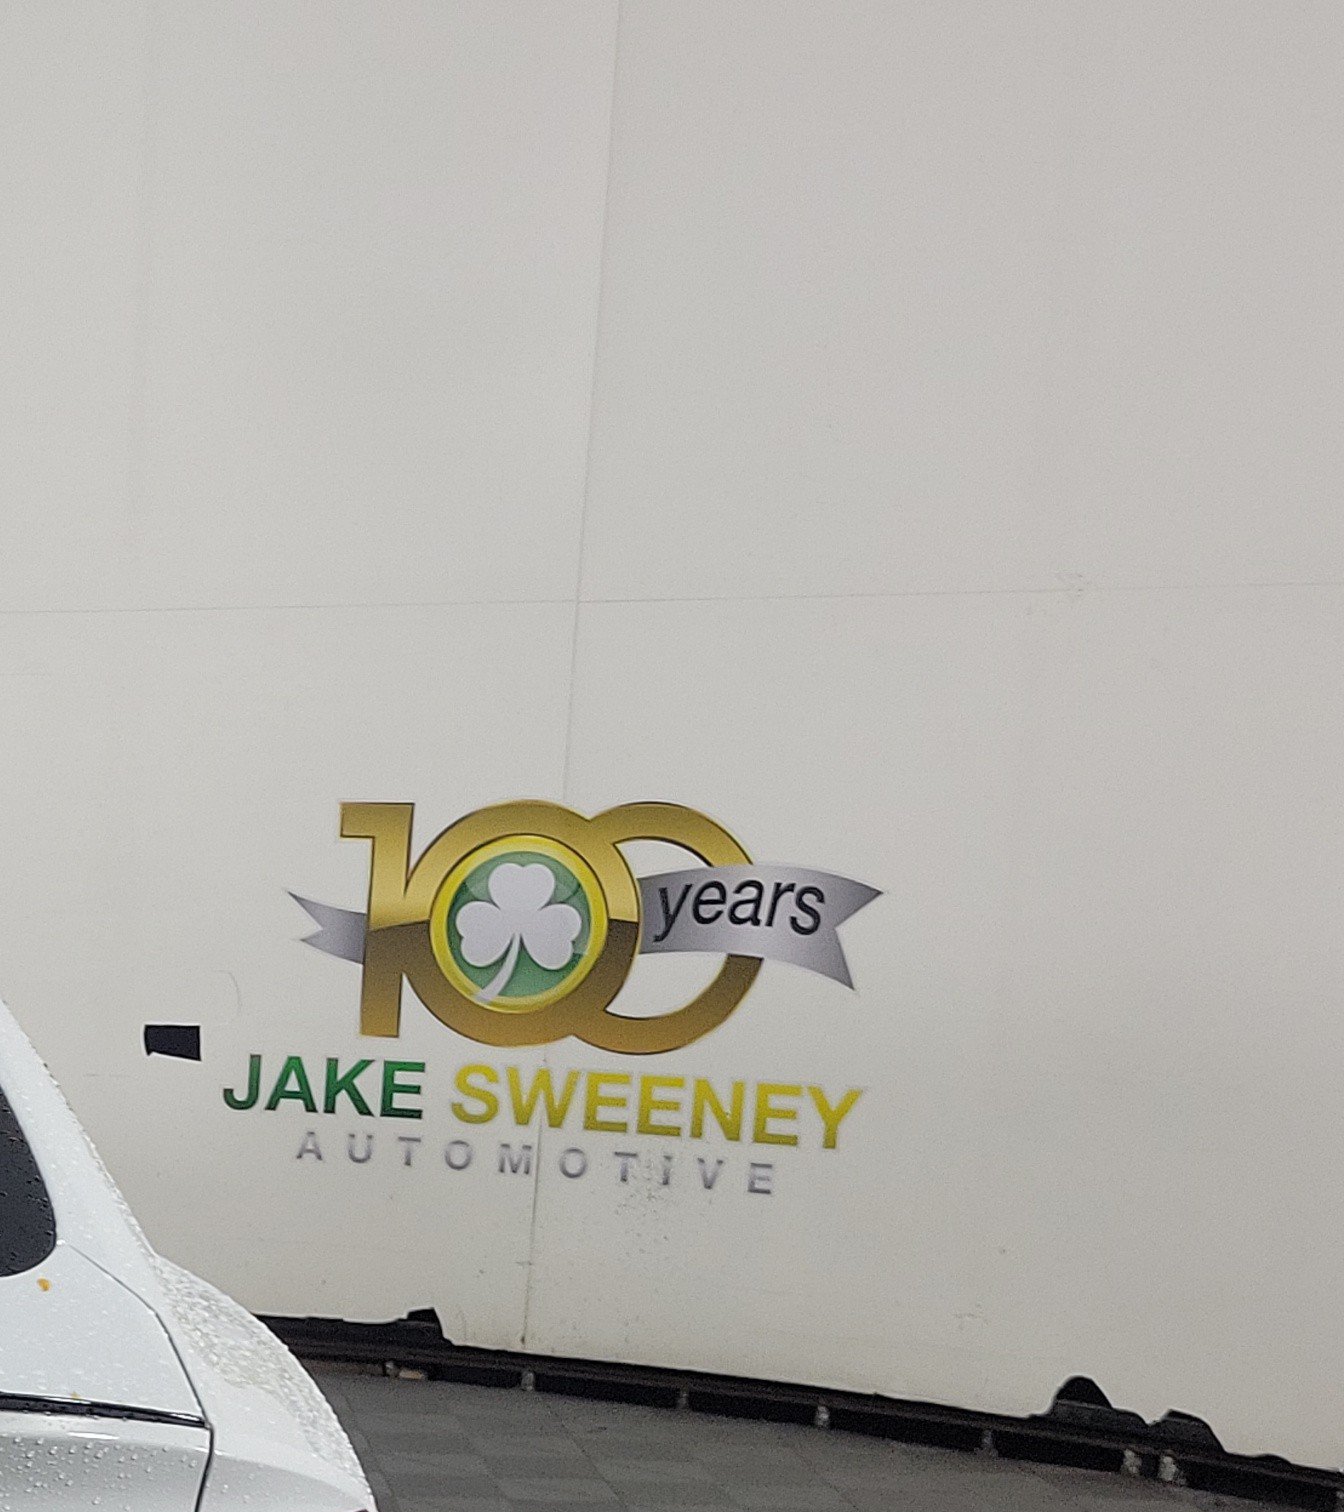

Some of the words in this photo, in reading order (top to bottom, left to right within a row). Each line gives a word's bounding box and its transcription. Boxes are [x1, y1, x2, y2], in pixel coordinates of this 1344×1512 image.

[339, 799, 765, 1055] 100
[653, 878, 826, 944] years
[222, 1053, 426, 1121] JAKE
[450, 1063, 865, 1150] SWEENEY
[295, 1130, 775, 1196] AUTOMOTIVE
